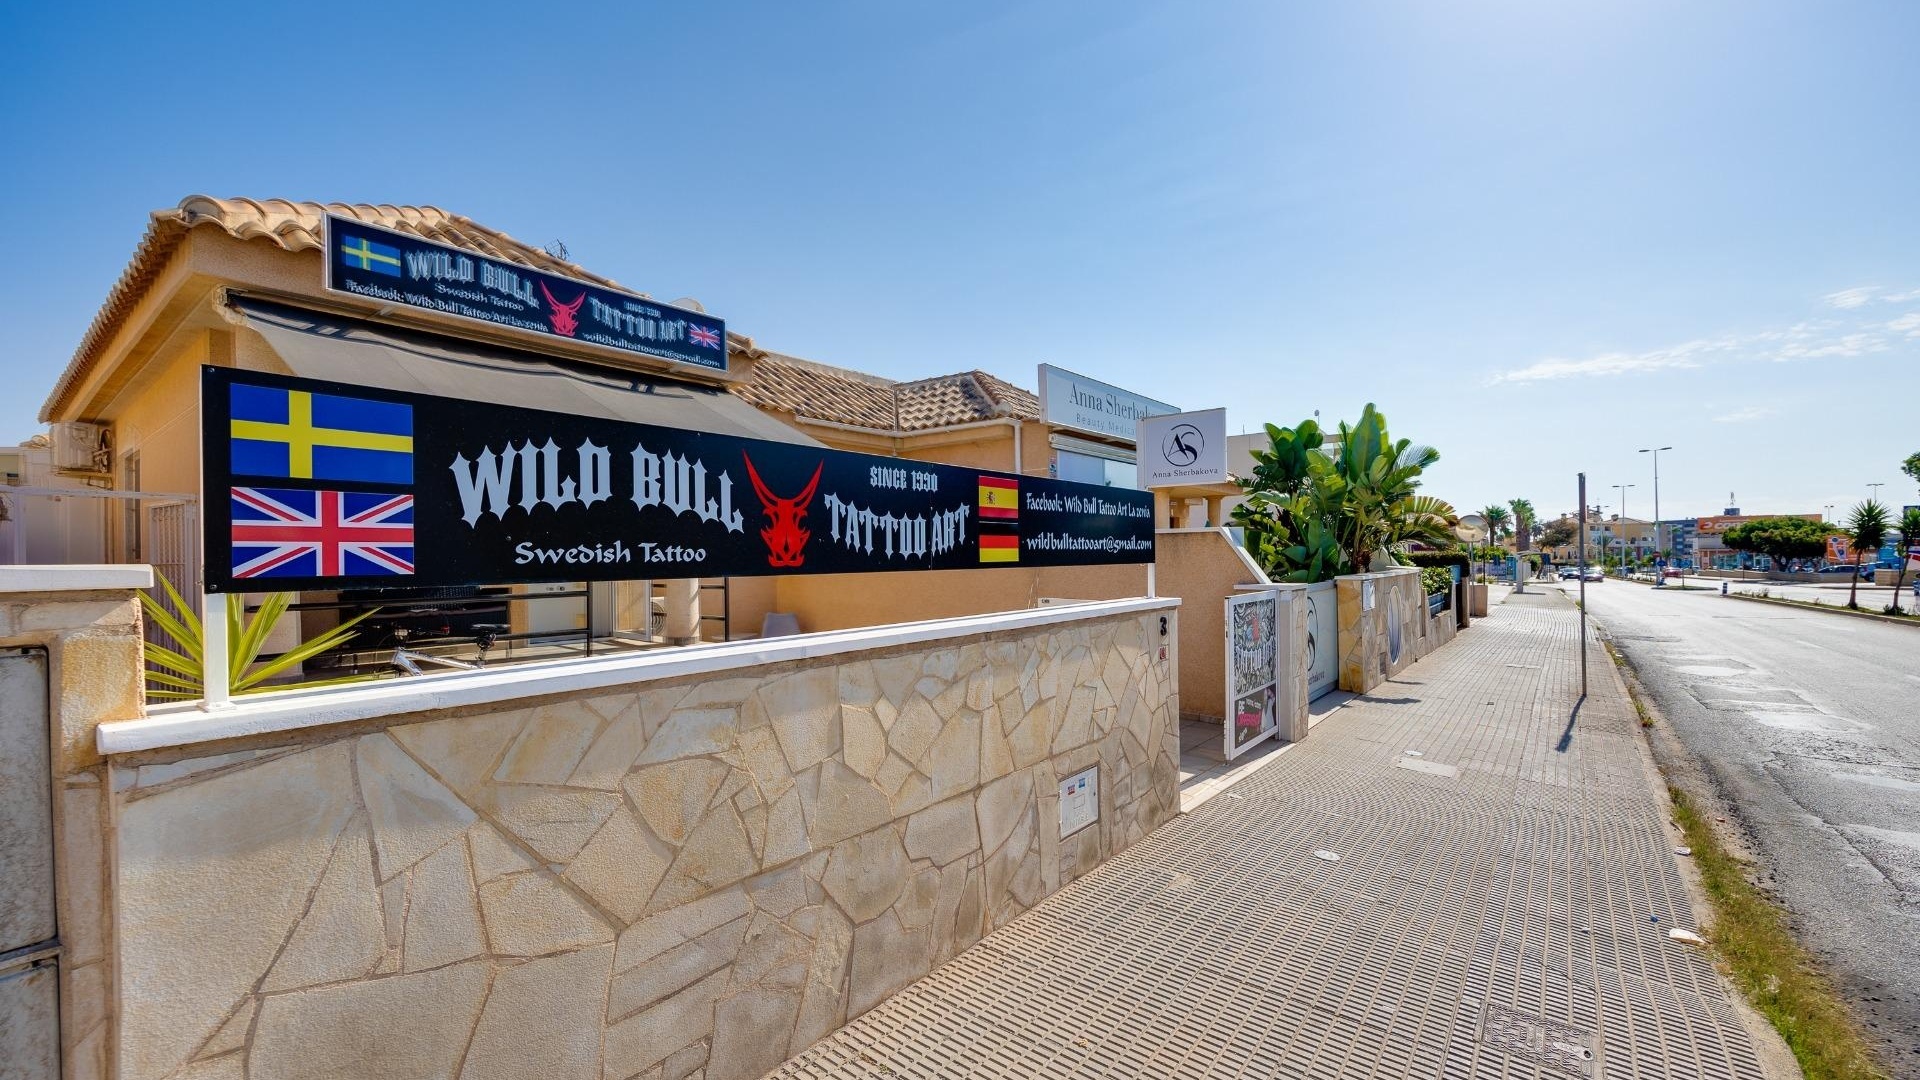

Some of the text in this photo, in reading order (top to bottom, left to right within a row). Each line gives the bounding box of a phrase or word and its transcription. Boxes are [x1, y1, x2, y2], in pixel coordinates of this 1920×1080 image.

[404, 250, 540, 310] WILD BULL
[588, 296, 687, 342] TATTOO ART
[1069, 381, 1102, 412] Anna
[1076, 412, 1105, 431] Beauty
[449, 436, 745, 534] WILD BULL
[869, 463, 938, 493] SINCE 1990
[1152, 467, 1218, 479] Anna Sherbakova
[1026, 491, 1063, 512] Facebook:
[1063, 495, 1082, 514] Wild
[1083, 496, 1097, 515] Bull
[1098, 499, 1117, 516] Tattoo
[1117, 501, 1128, 517] Art
[1128, 502, 1136, 518] La
[823, 491, 970, 561] TATTOO ART
[515, 540, 707, 565] Swedish Tattoo
[1026, 531, 1152, 554] wildbulltattooart@gmail.com
[1159, 616, 1168, 637] 3
